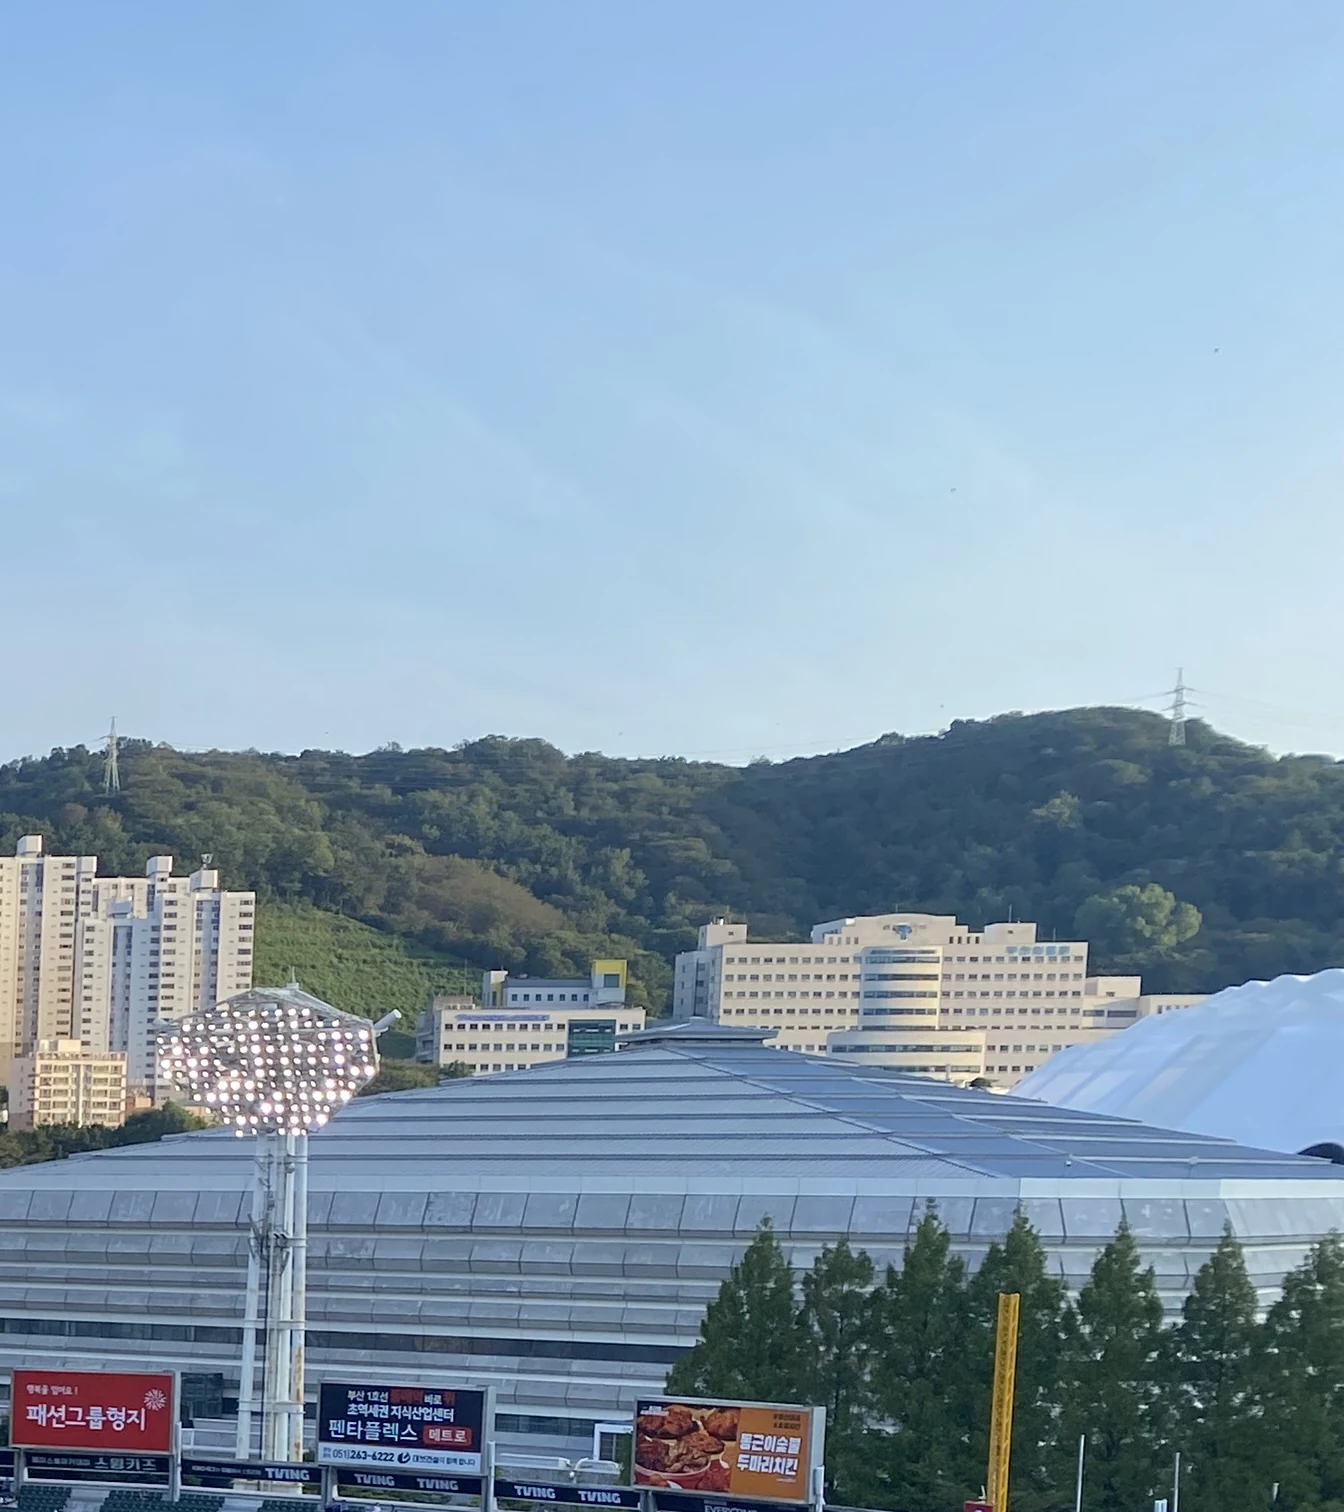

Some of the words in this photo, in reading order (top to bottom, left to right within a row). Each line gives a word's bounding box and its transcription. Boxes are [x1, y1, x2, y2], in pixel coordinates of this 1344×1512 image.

[348, 1390, 364, 1401] 부산
[26, 1403, 146, 1431] 패션그룹형지
[390, 1405, 454, 1422] 지식산업센터
[328, 1419, 418, 1441] 펜타플렉스
[429, 1428, 467, 1443] 메트로
[265, 1466, 310, 1481] TVING
[736, 1454, 798, 1477] 두마리치킨
[354, 1473, 395, 1486] TVING
[417, 1478, 459, 1491] TVING
[514, 1485, 556, 1499] TVING
[578, 1490, 621, 1504] TVING
